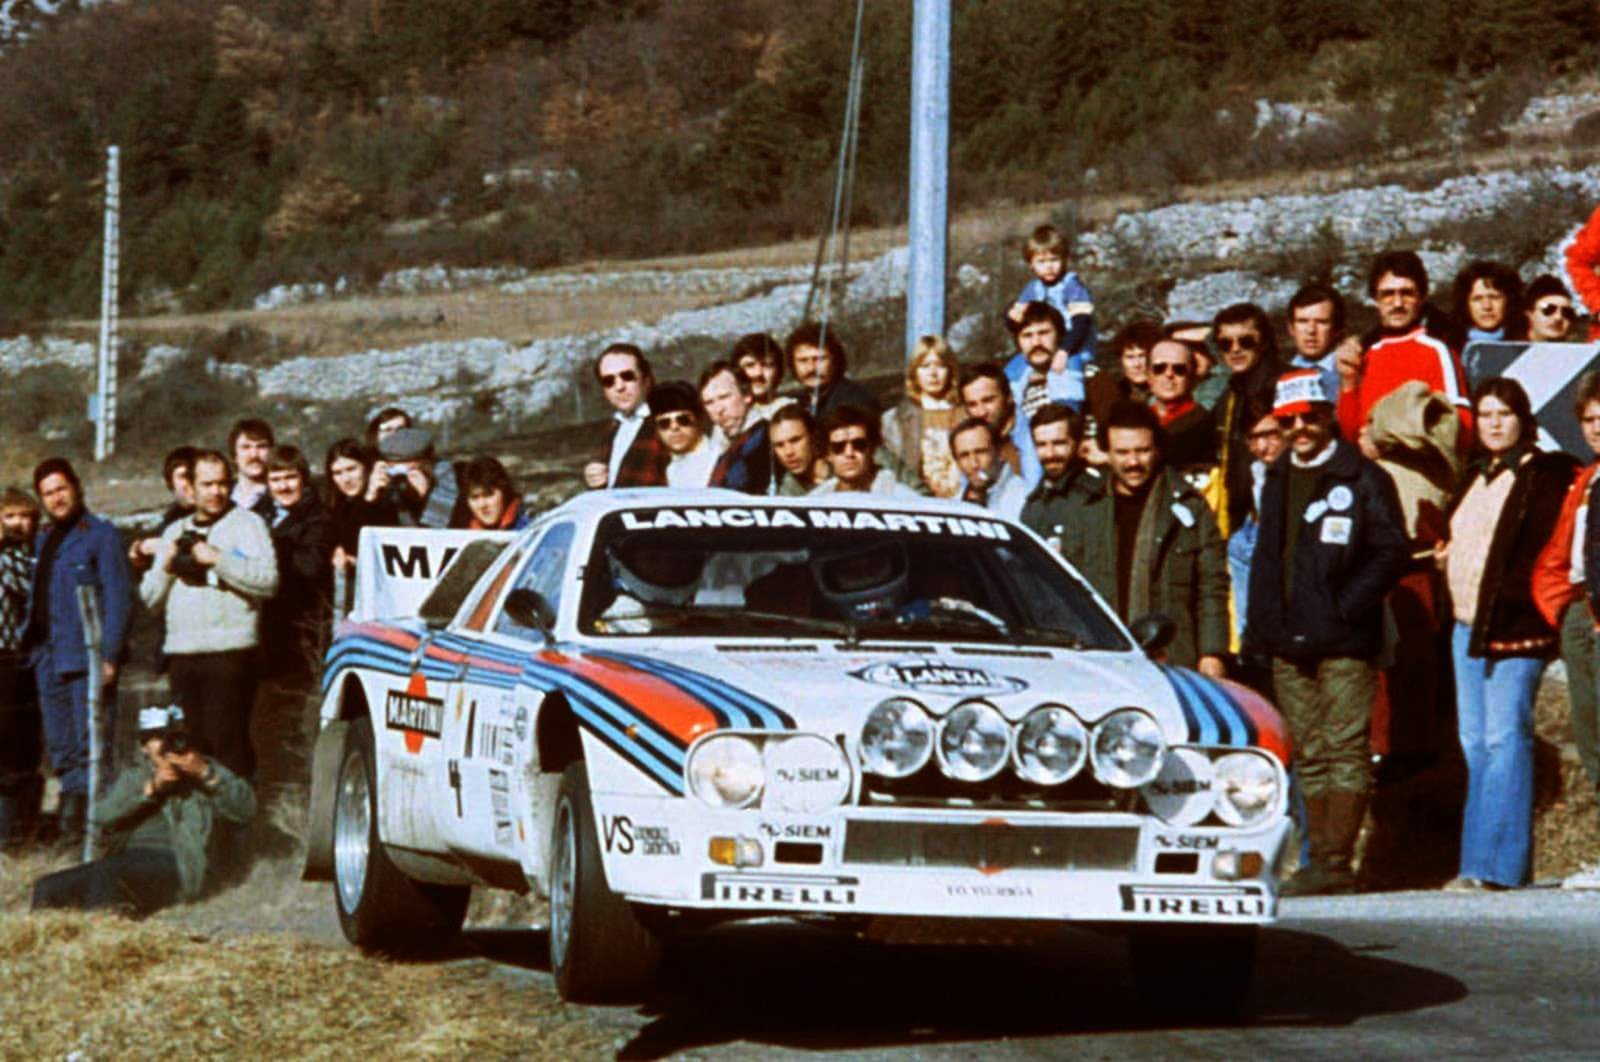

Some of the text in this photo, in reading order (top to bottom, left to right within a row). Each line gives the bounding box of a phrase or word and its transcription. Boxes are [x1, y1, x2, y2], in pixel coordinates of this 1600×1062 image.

[620, 509, 1012, 541] LANCIA MARTINI
[904, 668, 990, 686] LANCIA
[387, 694, 444, 735] MARTINI
[799, 768, 840, 782] SIEM
[784, 824, 832, 839] SIEM
[701, 872, 859, 905] PIRELLI
[1119, 884, 1264, 915] PIRELLI
